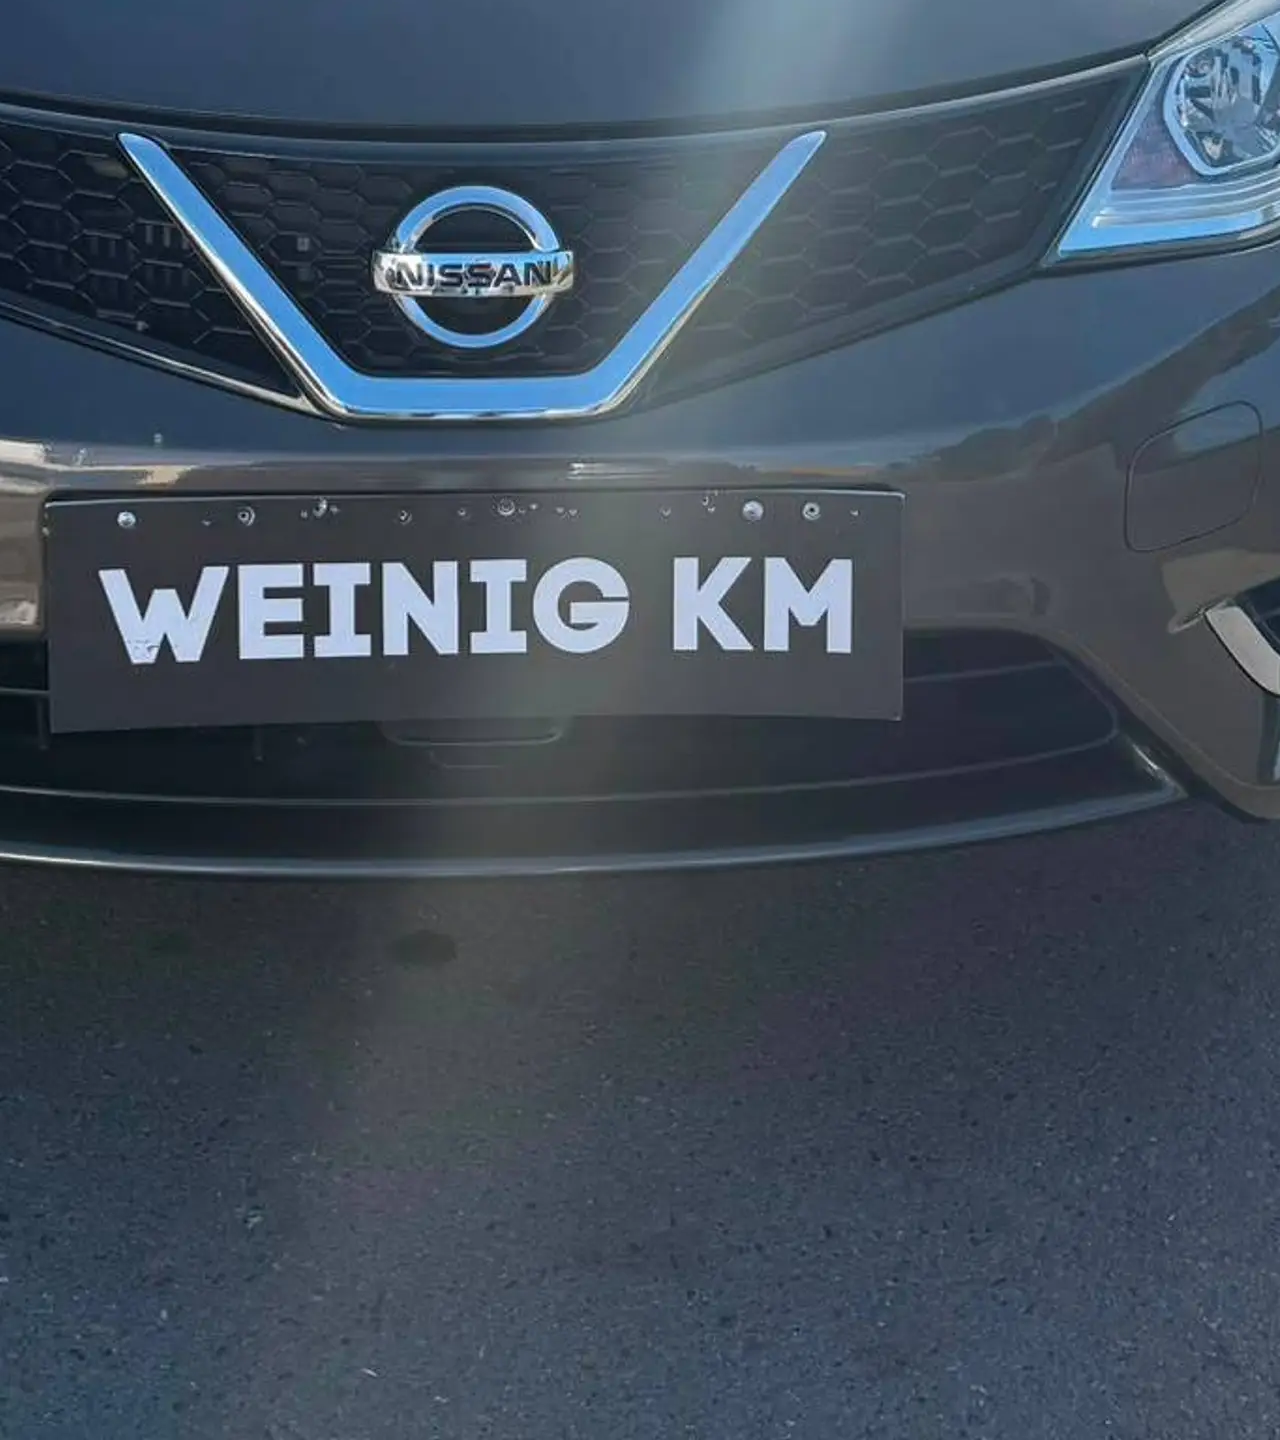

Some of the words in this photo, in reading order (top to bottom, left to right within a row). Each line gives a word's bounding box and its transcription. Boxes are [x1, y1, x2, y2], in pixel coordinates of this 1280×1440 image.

[394, 261, 553, 290] NISSAN
[98, 557, 630, 664] WEINIG
[673, 556, 854, 654] KM
